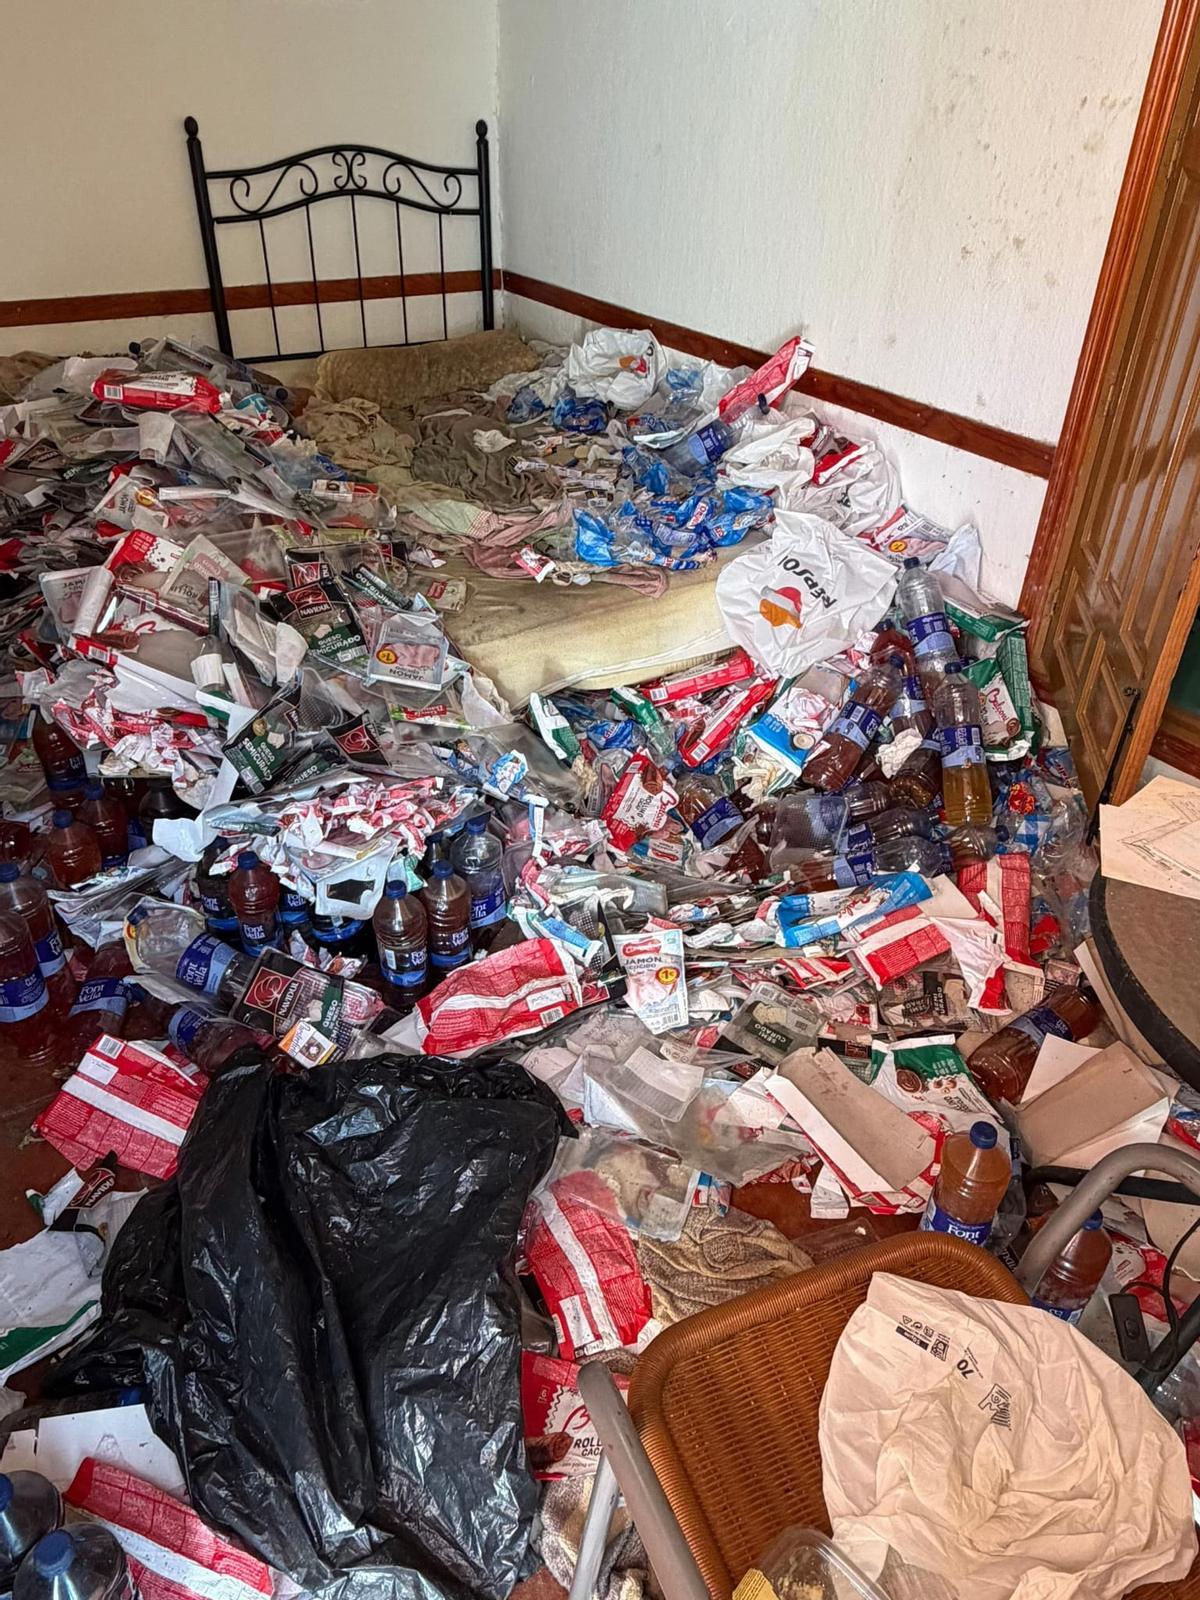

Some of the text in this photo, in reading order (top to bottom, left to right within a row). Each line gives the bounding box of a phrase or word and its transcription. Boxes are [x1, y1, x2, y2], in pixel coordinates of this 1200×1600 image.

[260, 741, 275, 763] QUESO
[278, 981, 300, 1016] NAVIDUL
[937, 986, 945, 1014] URADO
[322, 999, 338, 1028] QUESO
[754, 1023, 786, 1043] CURADO
[758, 1031, 777, 1044] SEMI
[84, 1177, 115, 1206] NAVIDU
[947, 1224, 980, 1239] Font
[956, 1359, 975, 1380] 70
[573, 1437, 602, 1449] ROLL
